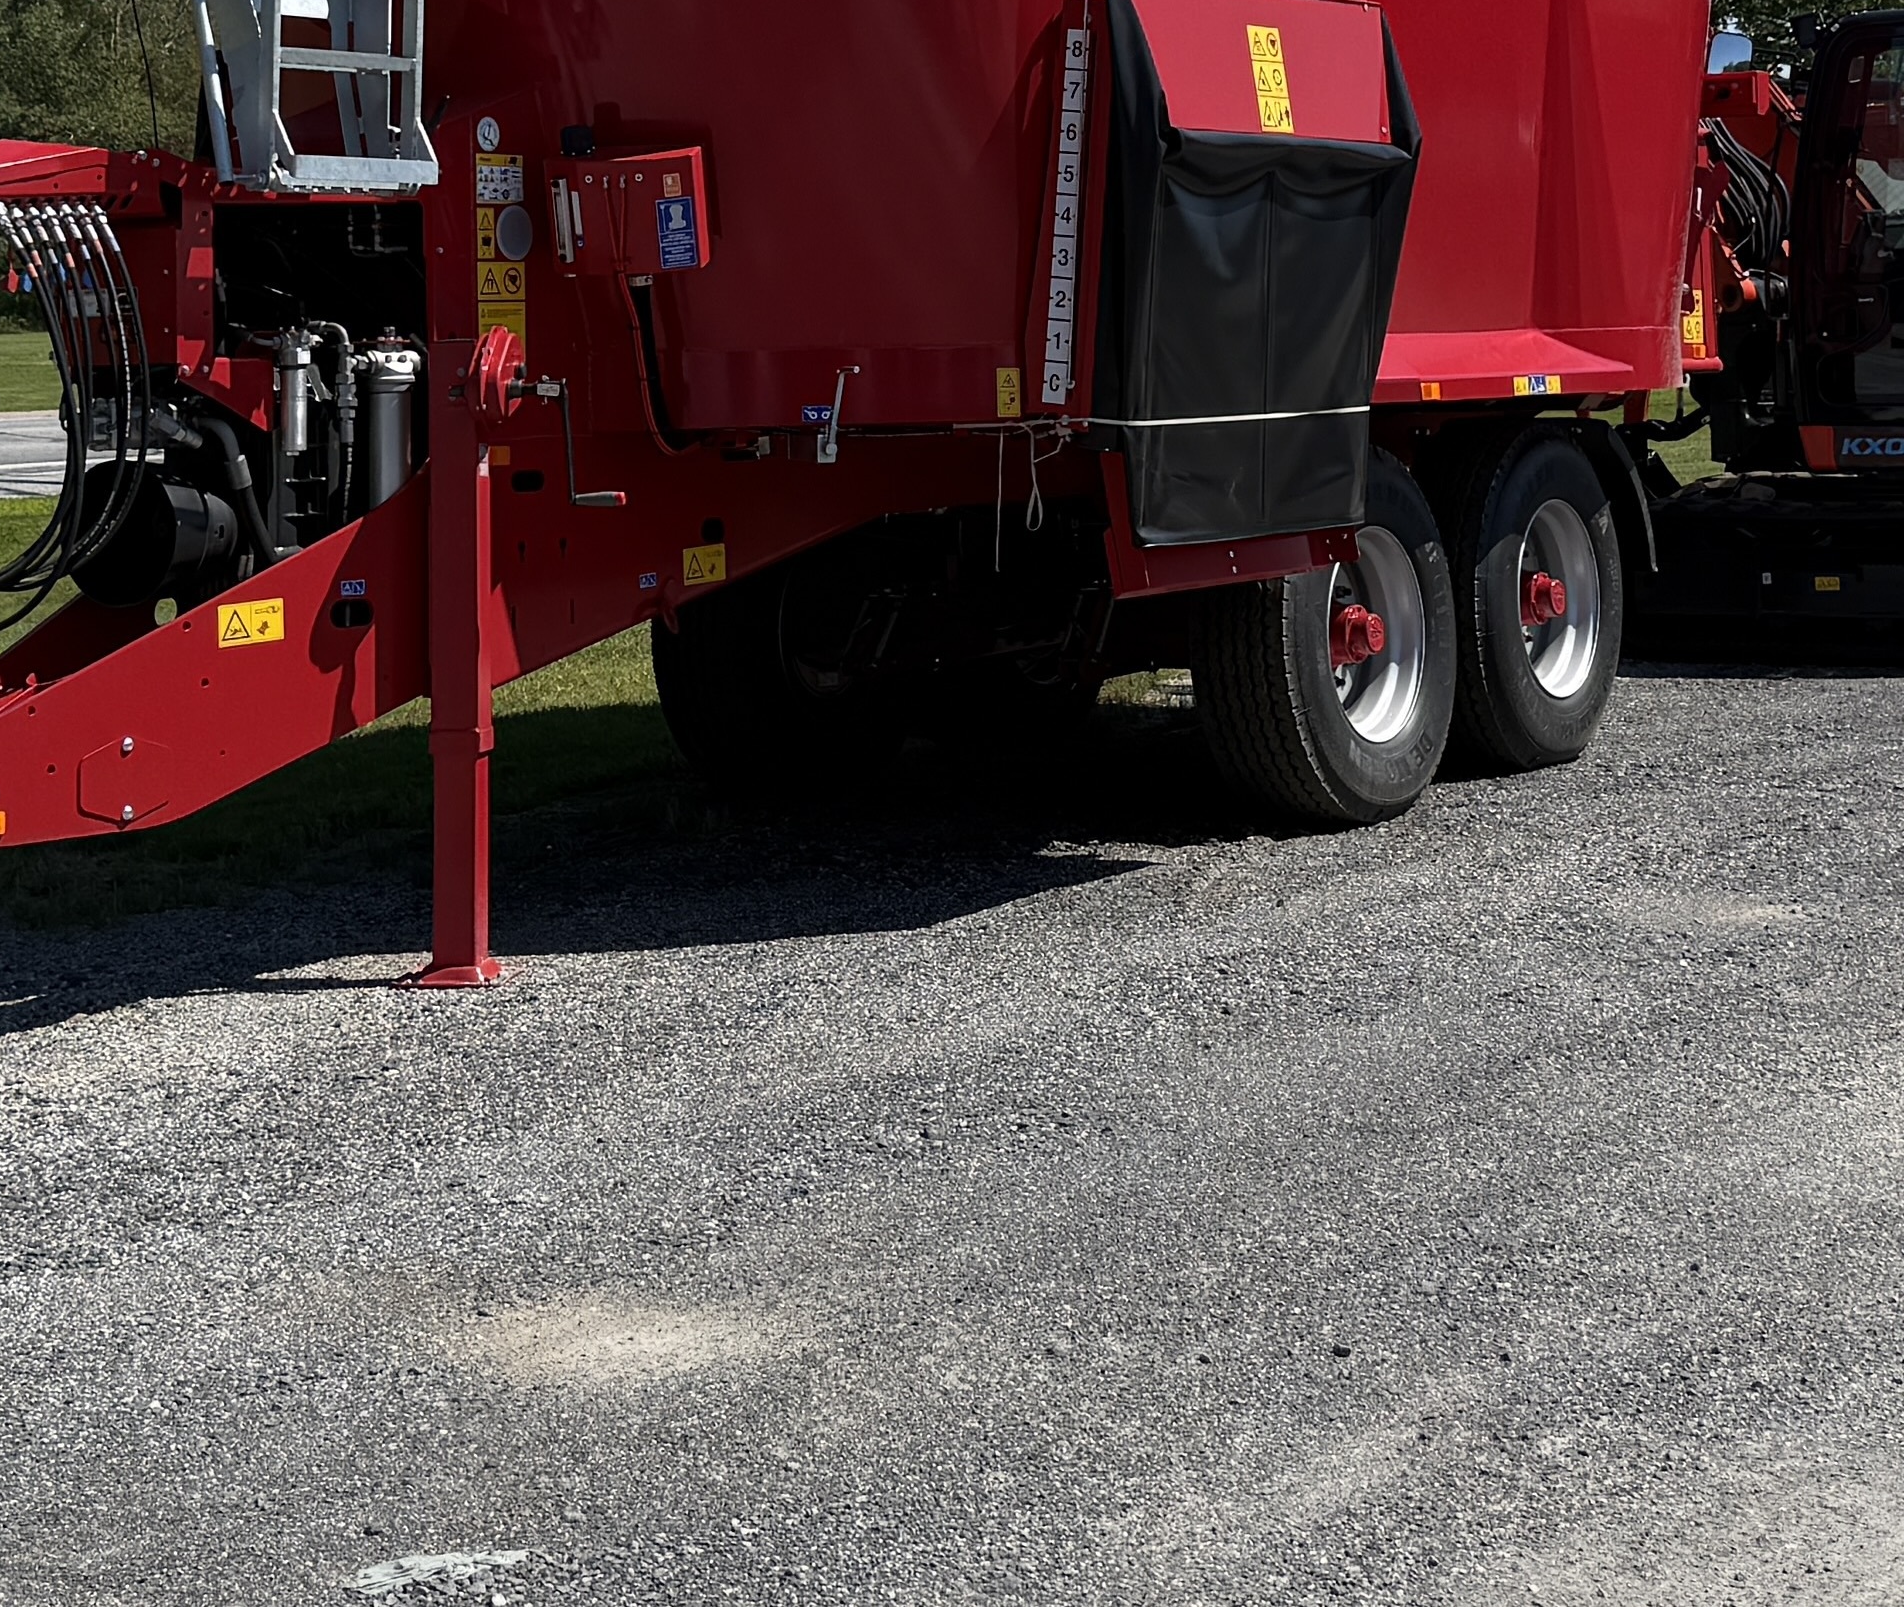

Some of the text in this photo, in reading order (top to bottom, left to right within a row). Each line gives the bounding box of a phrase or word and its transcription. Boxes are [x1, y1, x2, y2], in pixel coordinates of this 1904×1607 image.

[1071, 40, 1083, 58] 8
[1069, 81, 1081, 99] 7
[1066, 123, 1077, 141] 6
[1063, 165, 1074, 183] 5
[1060, 206, 1072, 224] 4
[1057, 248, 1069, 266] 3
[1054, 290, 1066, 308] 2
[1053, 331, 1061, 350] 1
